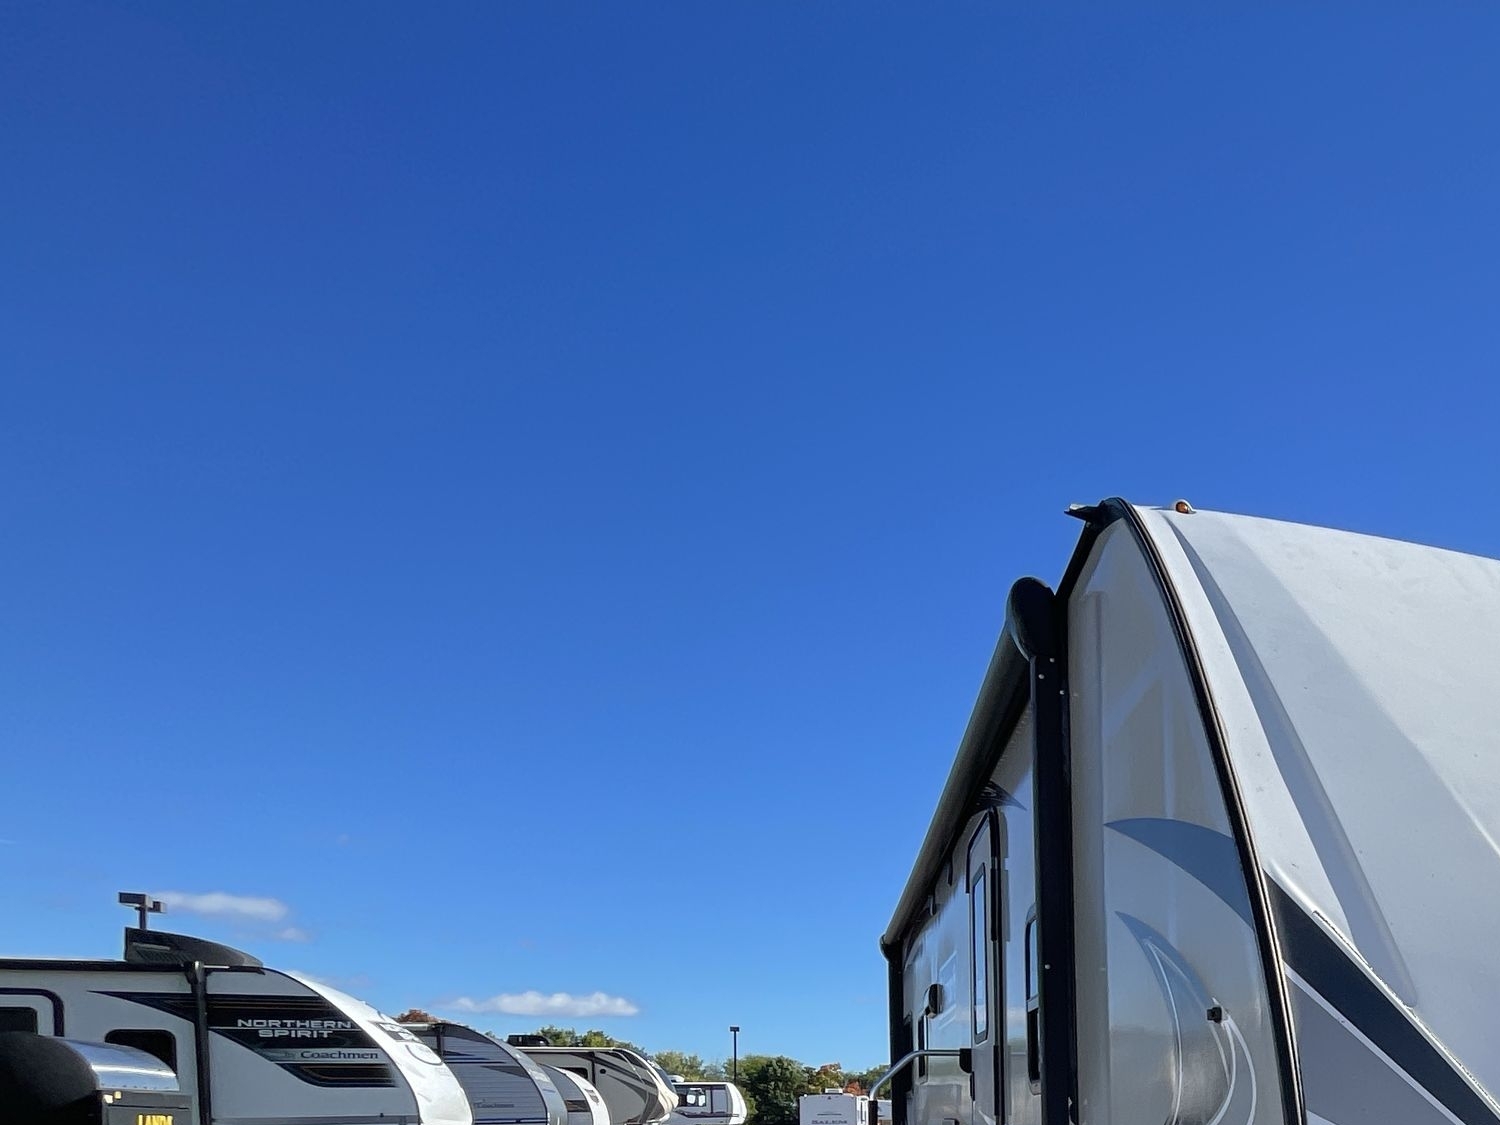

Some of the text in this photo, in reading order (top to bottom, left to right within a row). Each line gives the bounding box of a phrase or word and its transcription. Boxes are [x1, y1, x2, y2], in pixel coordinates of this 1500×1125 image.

[237, 1019, 351, 1029] NORTHERN
[258, 1030, 333, 1038] SPIRIT
[300, 1050, 378, 1060] Coachmen
